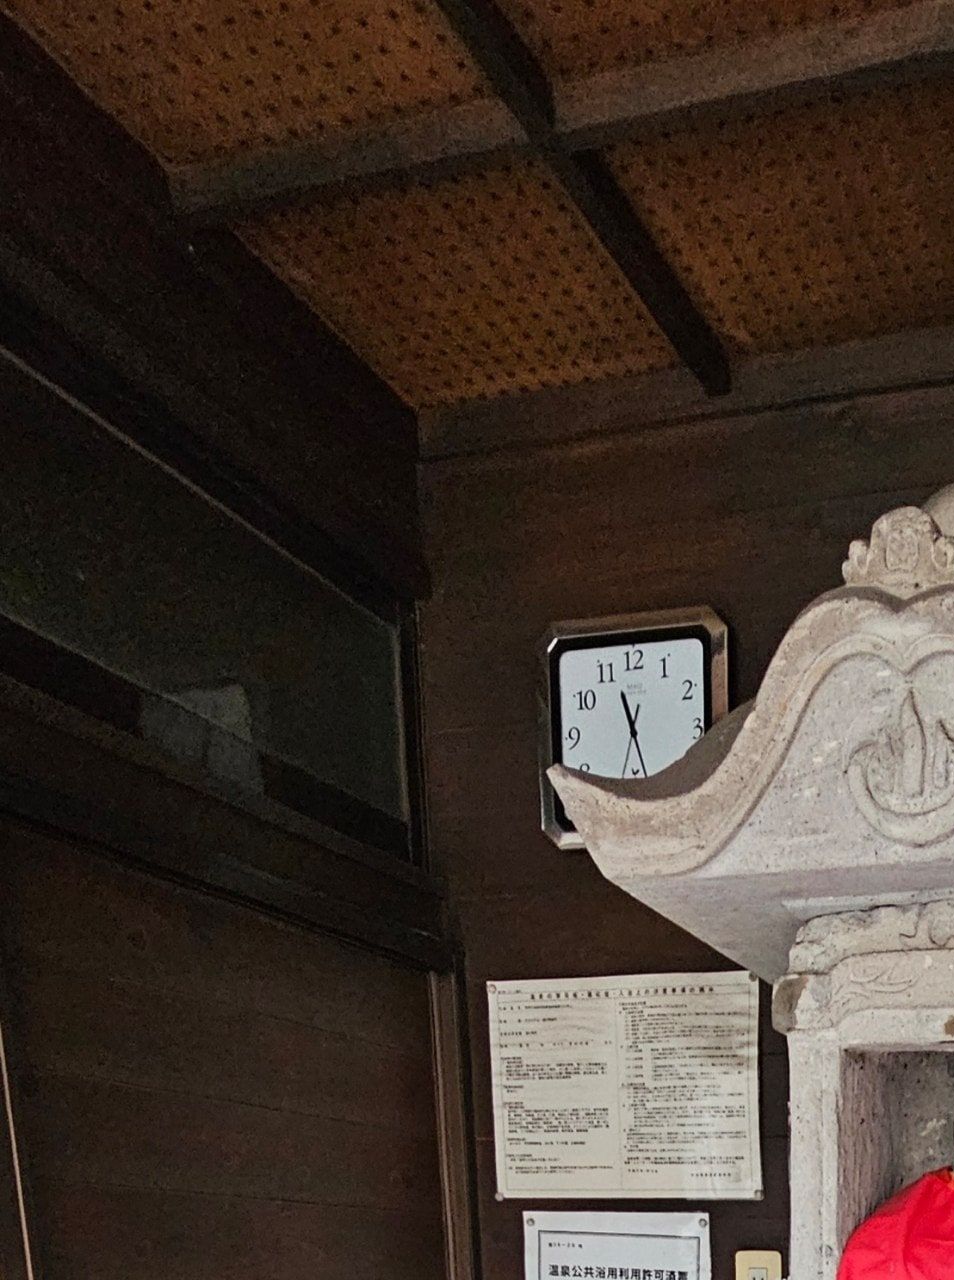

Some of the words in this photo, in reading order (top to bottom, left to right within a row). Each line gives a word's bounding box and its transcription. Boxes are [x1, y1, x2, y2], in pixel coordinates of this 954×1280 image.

[624, 650, 644, 672] 12
[660, 657, 668, 678] 1
[597, 662, 616, 683] 11
[577, 689, 596, 710] 10
[682, 680, 693, 700] 2
[568, 727, 581, 750] 9
[692, 718, 703, 739] 3
